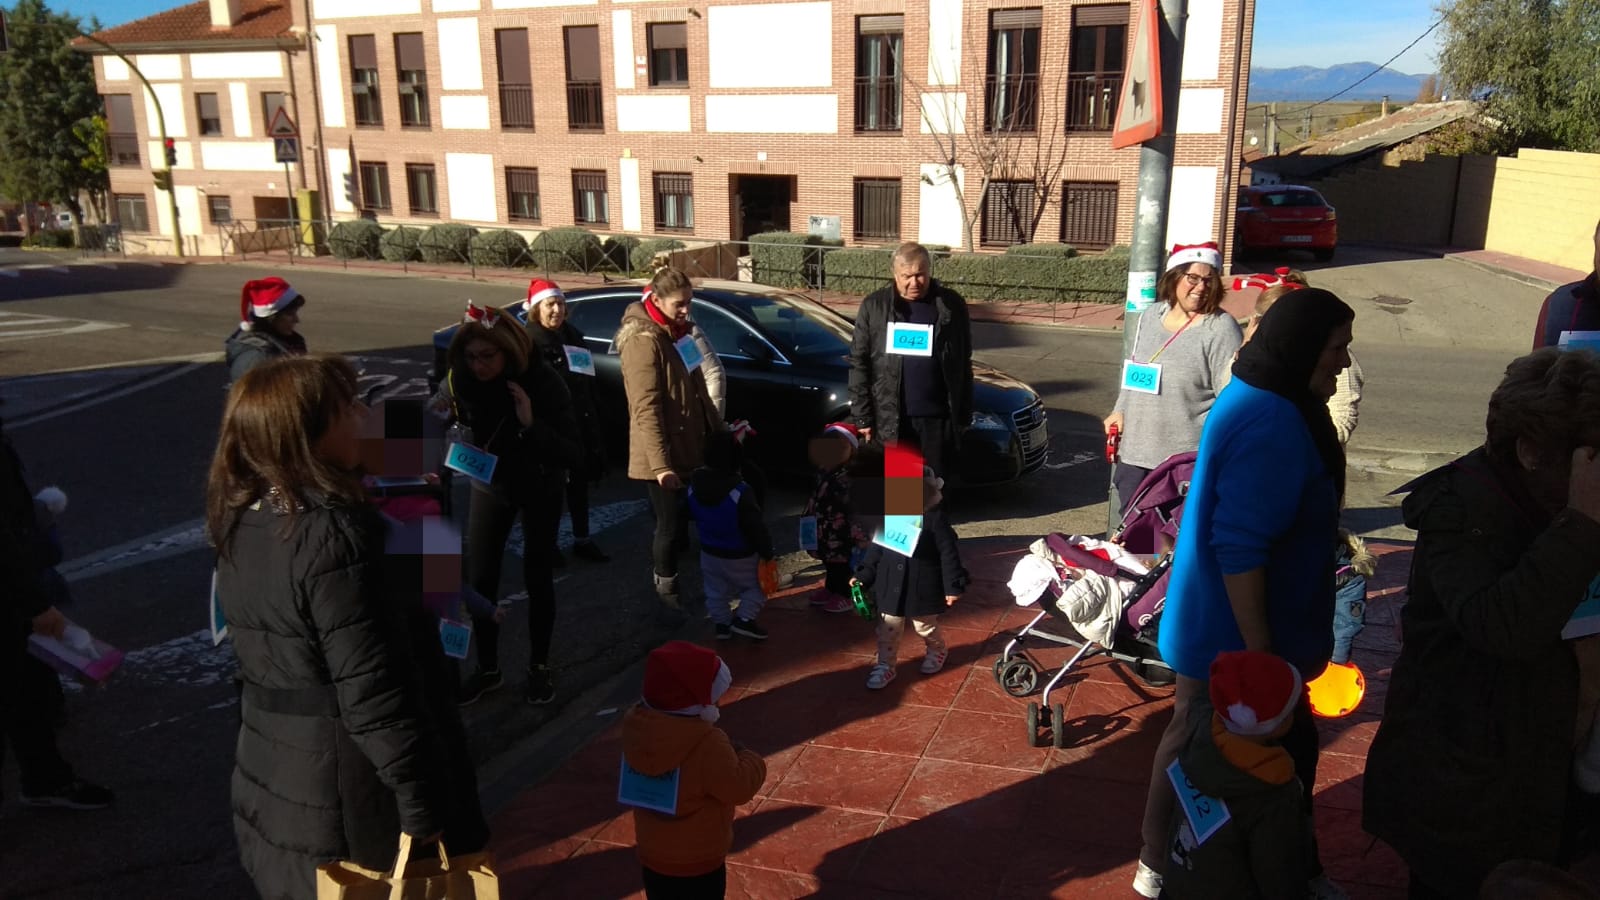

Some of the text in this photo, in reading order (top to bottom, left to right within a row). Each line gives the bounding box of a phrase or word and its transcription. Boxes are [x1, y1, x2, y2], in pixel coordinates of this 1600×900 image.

[898, 335, 924, 346] 042
[1131, 371, 1154, 386] 023
[886, 529, 908, 544] 011
[1184, 775, 1211, 819] 012
